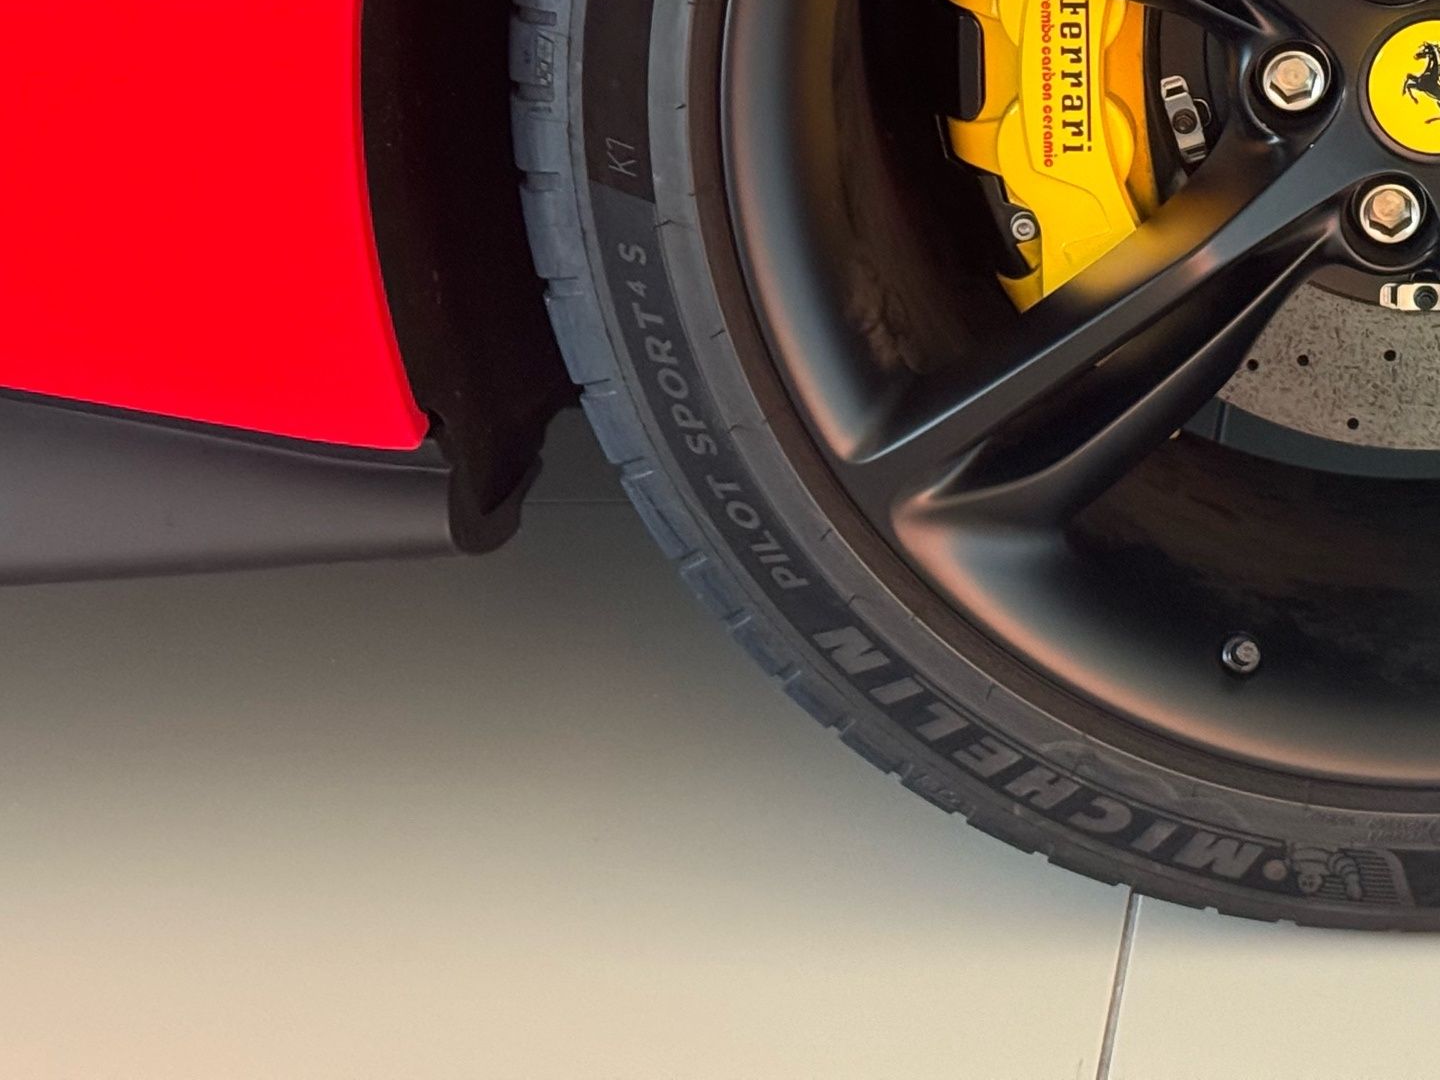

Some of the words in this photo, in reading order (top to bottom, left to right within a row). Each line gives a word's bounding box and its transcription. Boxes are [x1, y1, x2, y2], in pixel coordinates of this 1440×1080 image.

[1041, 46, 1054, 101] carbon
[1042, 105, 1054, 168] ceramic
[617, 243, 647, 266] S
[635, 306, 719, 457] SPORT
[699, 476, 808, 591] PILOT
[813, 626, 1263, 878] MICHELIN
